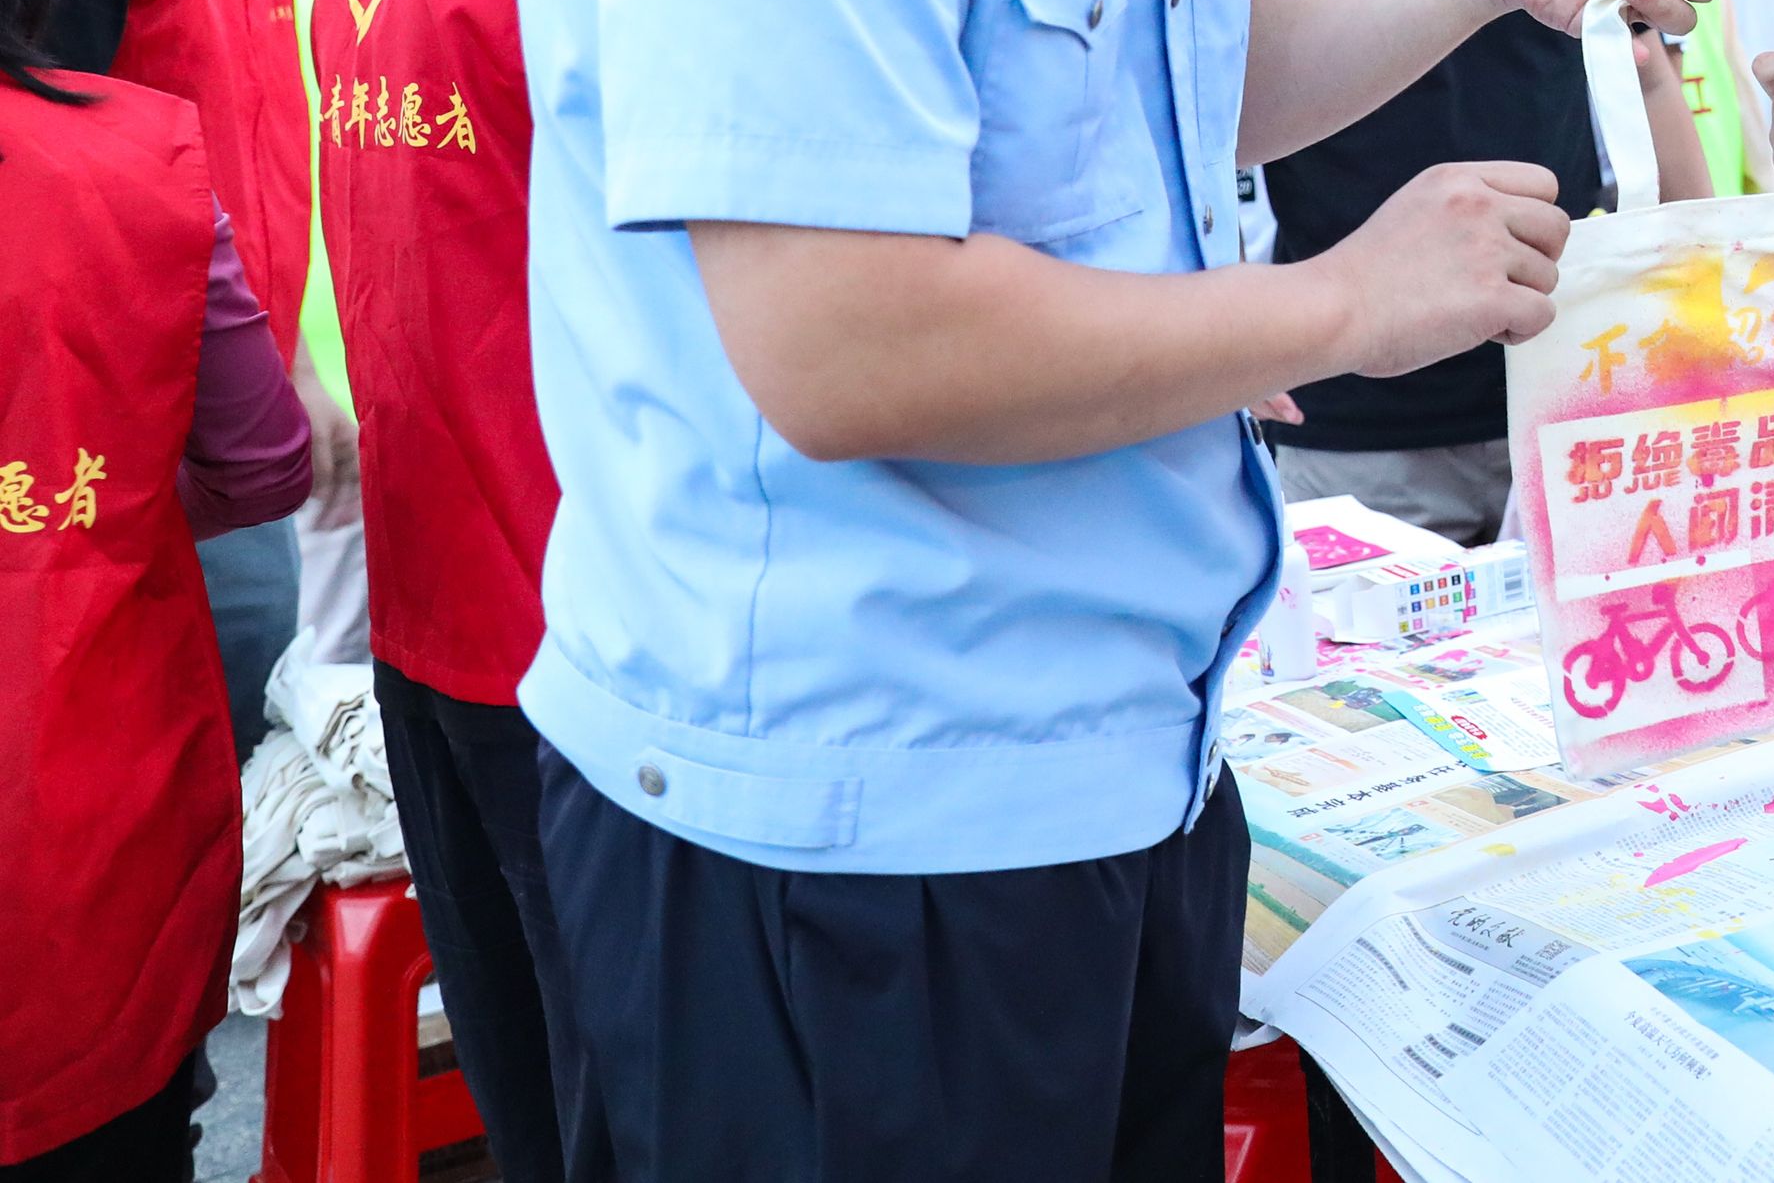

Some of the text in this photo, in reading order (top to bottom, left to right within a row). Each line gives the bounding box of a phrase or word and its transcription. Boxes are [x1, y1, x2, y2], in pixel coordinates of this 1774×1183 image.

[320, 74, 477, 155] 青年志愿者
[0, 447, 108, 533] 愿者
[1572, 470, 1682, 504] JU JUE
